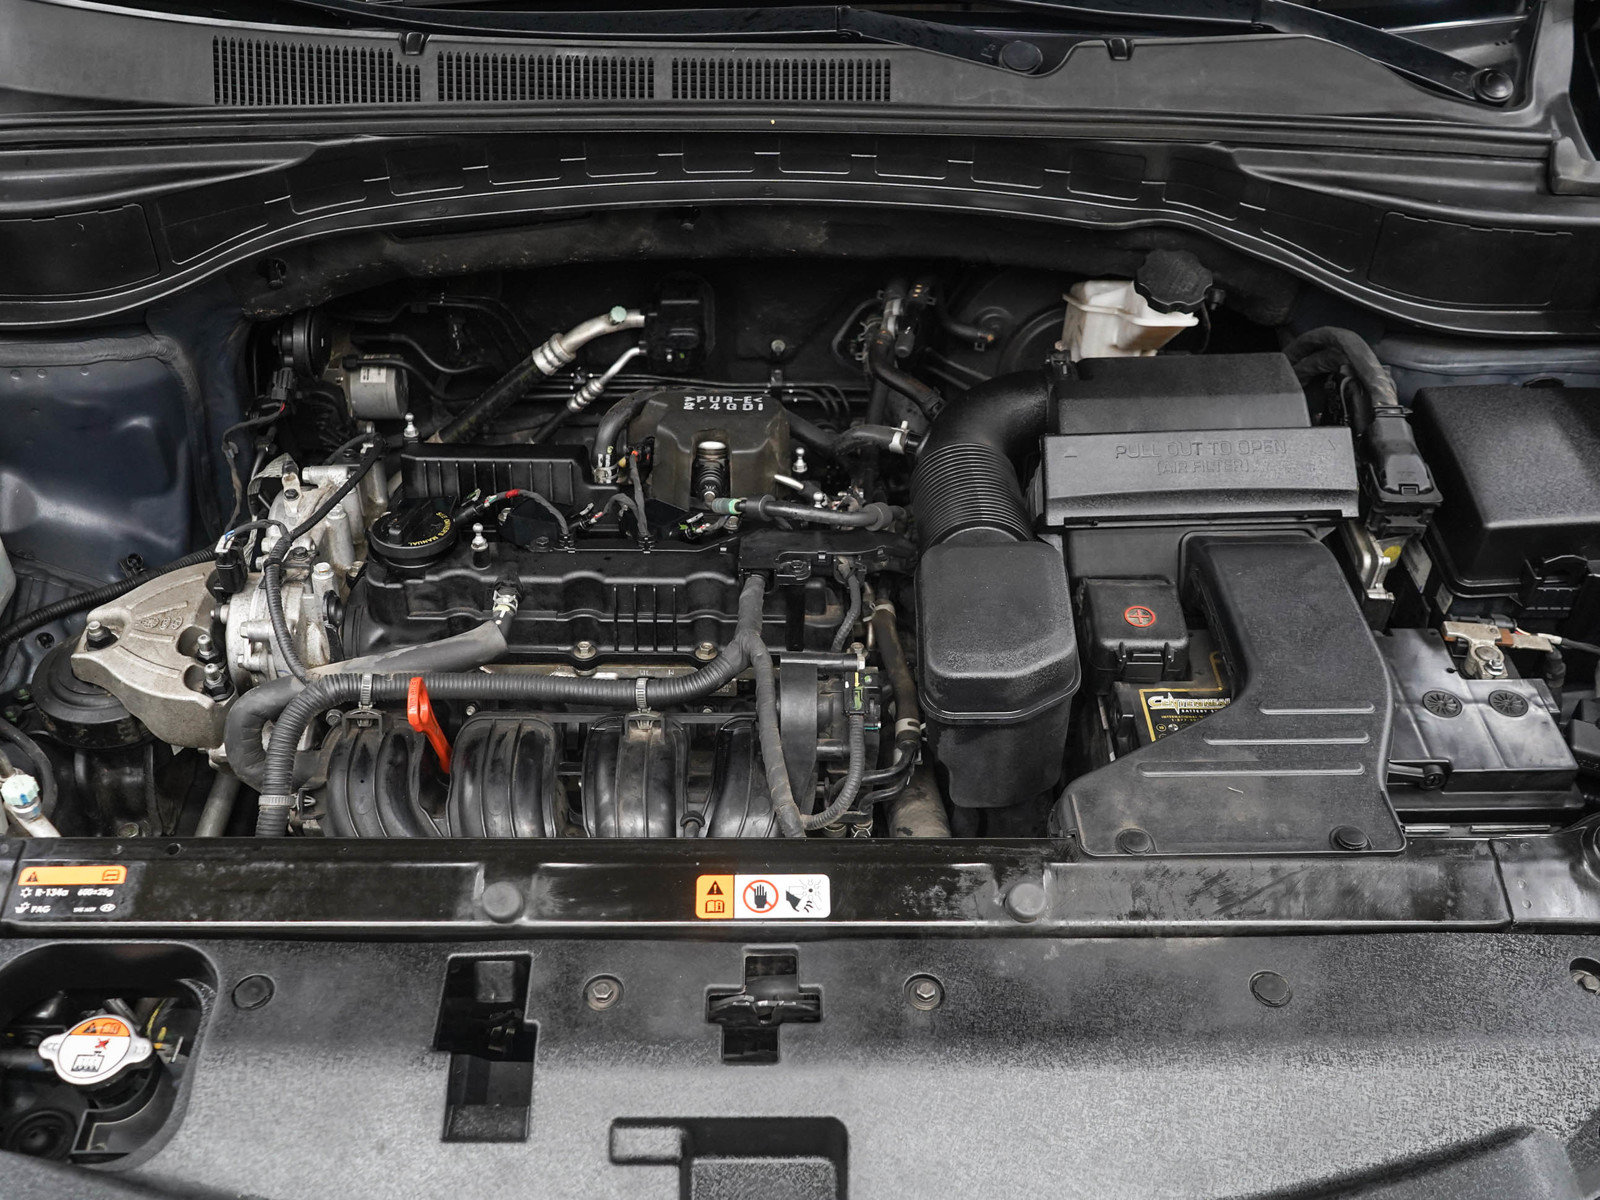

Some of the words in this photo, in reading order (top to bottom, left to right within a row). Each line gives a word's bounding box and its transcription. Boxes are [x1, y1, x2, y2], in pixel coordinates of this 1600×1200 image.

[1115, 443, 1161, 458] PULL
[1167, 441, 1203, 456] OUT
[1209, 441, 1232, 455] TO
[1238, 439, 1287, 455] OPEN
